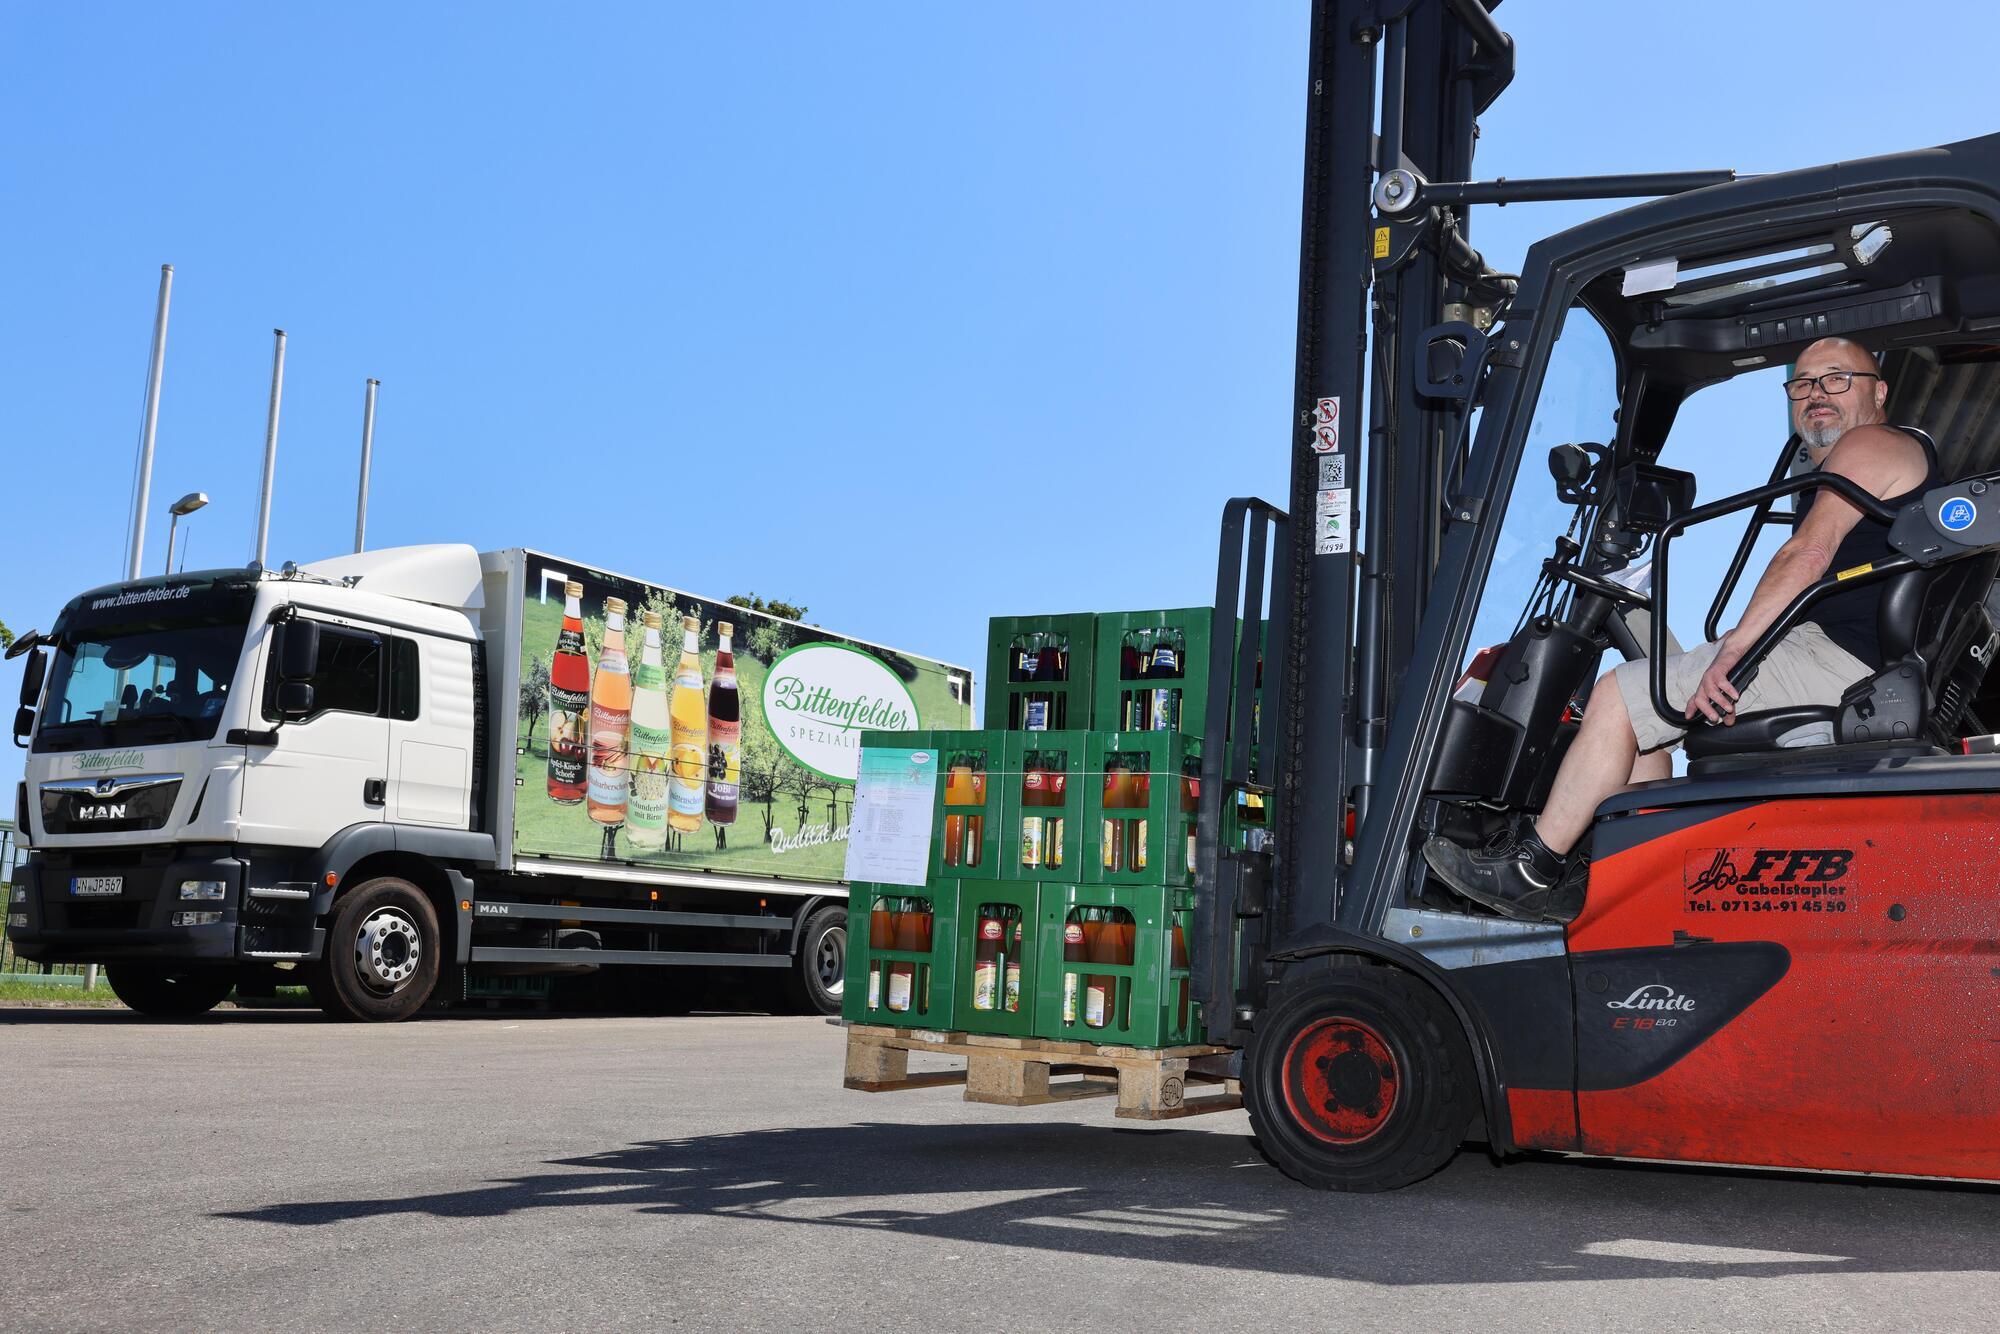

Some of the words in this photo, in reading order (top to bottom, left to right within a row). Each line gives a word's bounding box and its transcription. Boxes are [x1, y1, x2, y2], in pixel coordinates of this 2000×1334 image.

[92, 585, 190, 611] www.bittenfelder.de
[774, 676, 909, 733] Bittenfelder
[72, 750, 145, 773] Bittenfelder
[80, 805, 126, 819] MAN
[769, 822, 833, 854] Qualität
[1739, 850, 1853, 882] FFB
[92, 879, 104, 891] JP
[105, 878, 121, 891] 567
[1735, 883, 1846, 898] Gabelstapler
[480, 904, 509, 914] MAN
[1688, 901, 1716, 912] Tel.
[1721, 901, 1798, 912] 07134-91
[1802, 901, 1822, 912] 45
[1606, 984, 1696, 1011] Linde
[1612, 1017, 1631, 1029] E
[1655, 1018, 1677, 1027] EVO
